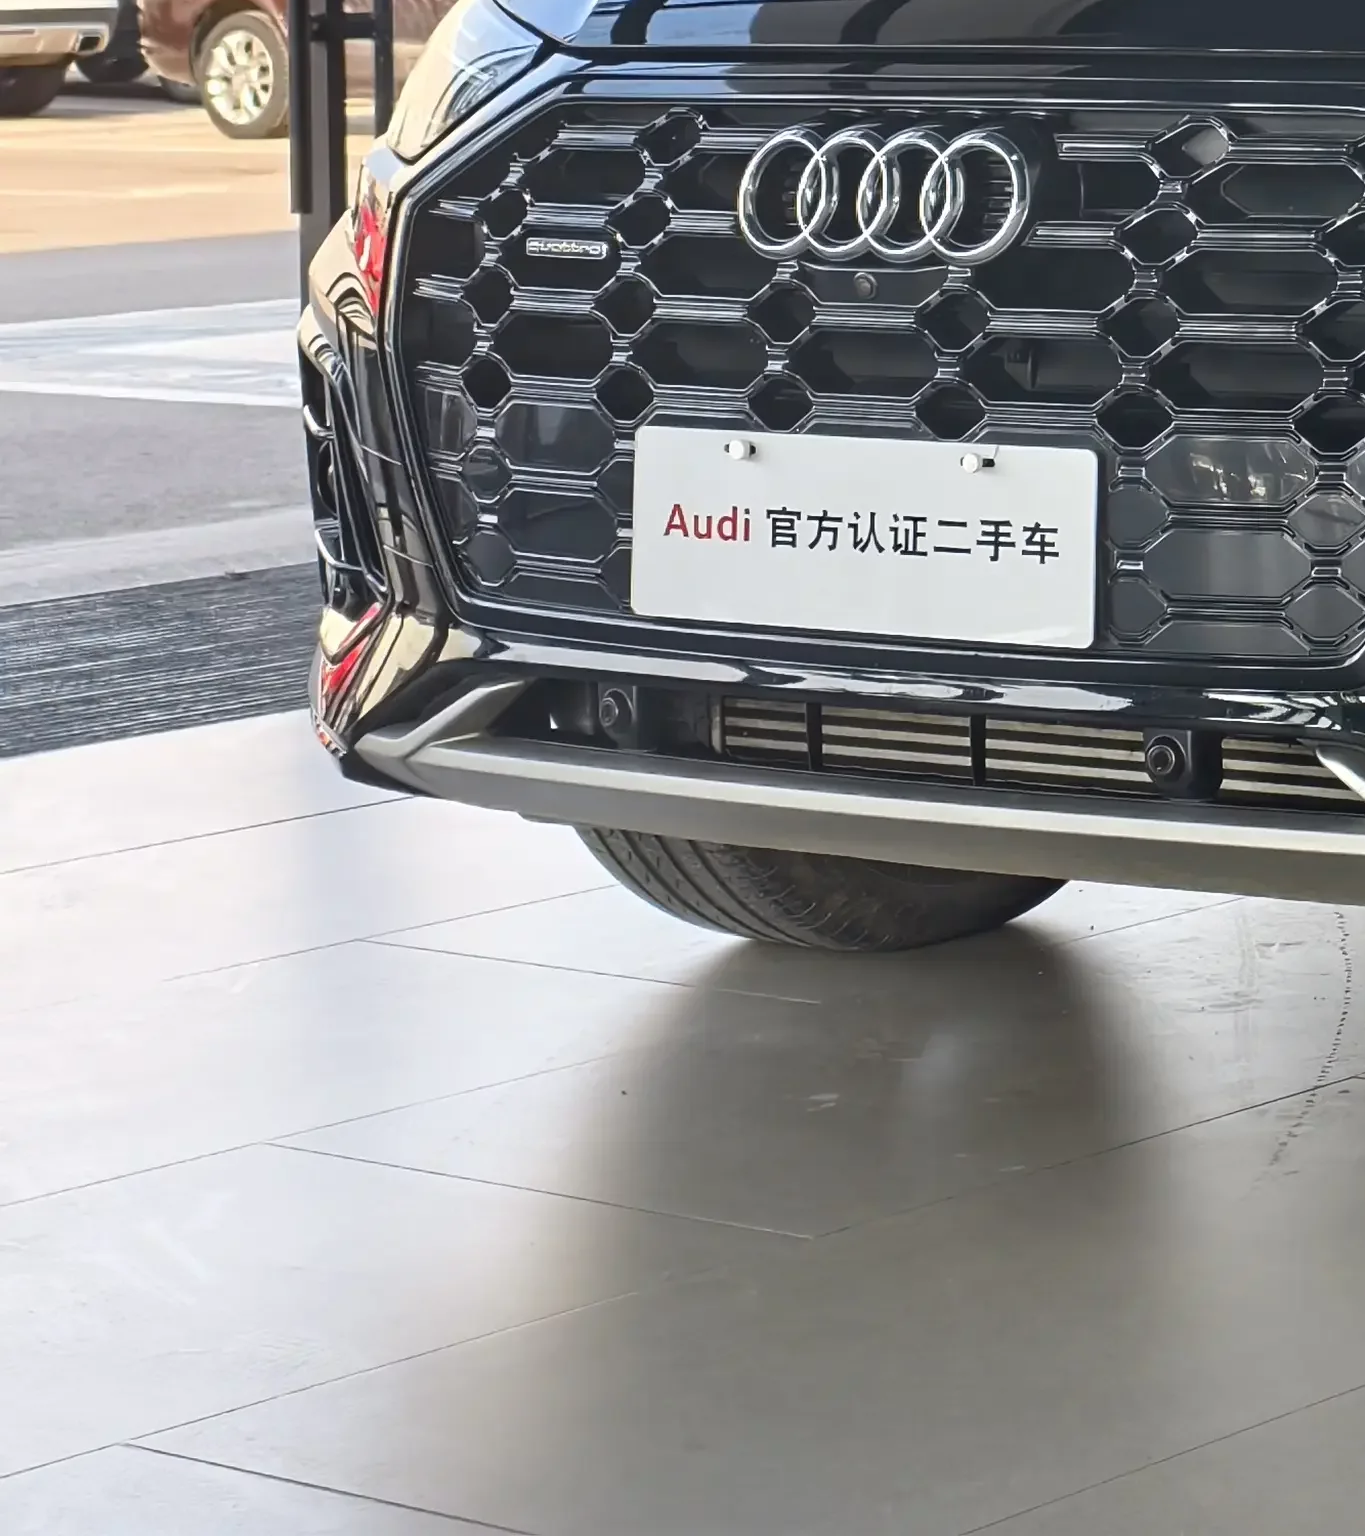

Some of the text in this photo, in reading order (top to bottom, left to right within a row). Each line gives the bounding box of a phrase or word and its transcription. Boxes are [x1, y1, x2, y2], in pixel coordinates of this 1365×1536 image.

[663, 503, 1060, 565] Audi 官方认证二手车
